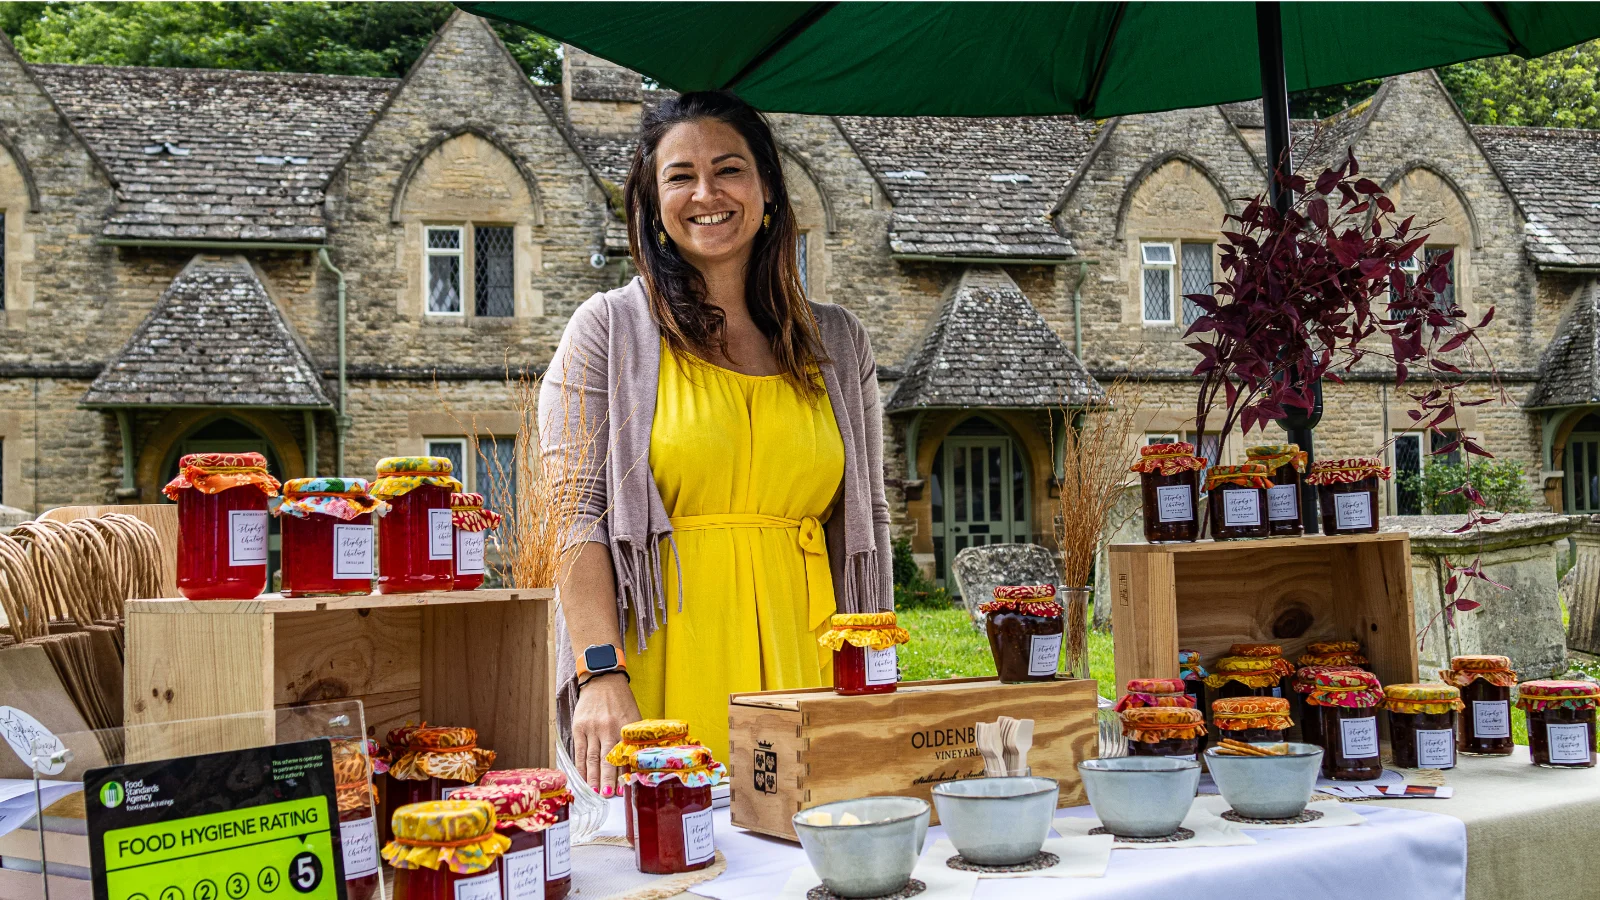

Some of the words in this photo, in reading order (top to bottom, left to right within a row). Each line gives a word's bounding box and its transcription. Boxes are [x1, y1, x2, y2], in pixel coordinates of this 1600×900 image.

[912, 727, 976, 749] OLDENB
[125, 778, 143, 789] Food
[125, 784, 159, 795] Standards
[126, 794, 152, 804] Agency
[118, 833, 176, 858] FOOD
[181, 818, 256, 846] HYGIENE
[260, 808, 318, 832] RATING
[200, 884, 210, 900] 2
[233, 878, 242, 894] 3
[263, 872, 272, 887] 4
[297, 856, 316, 888] 5
